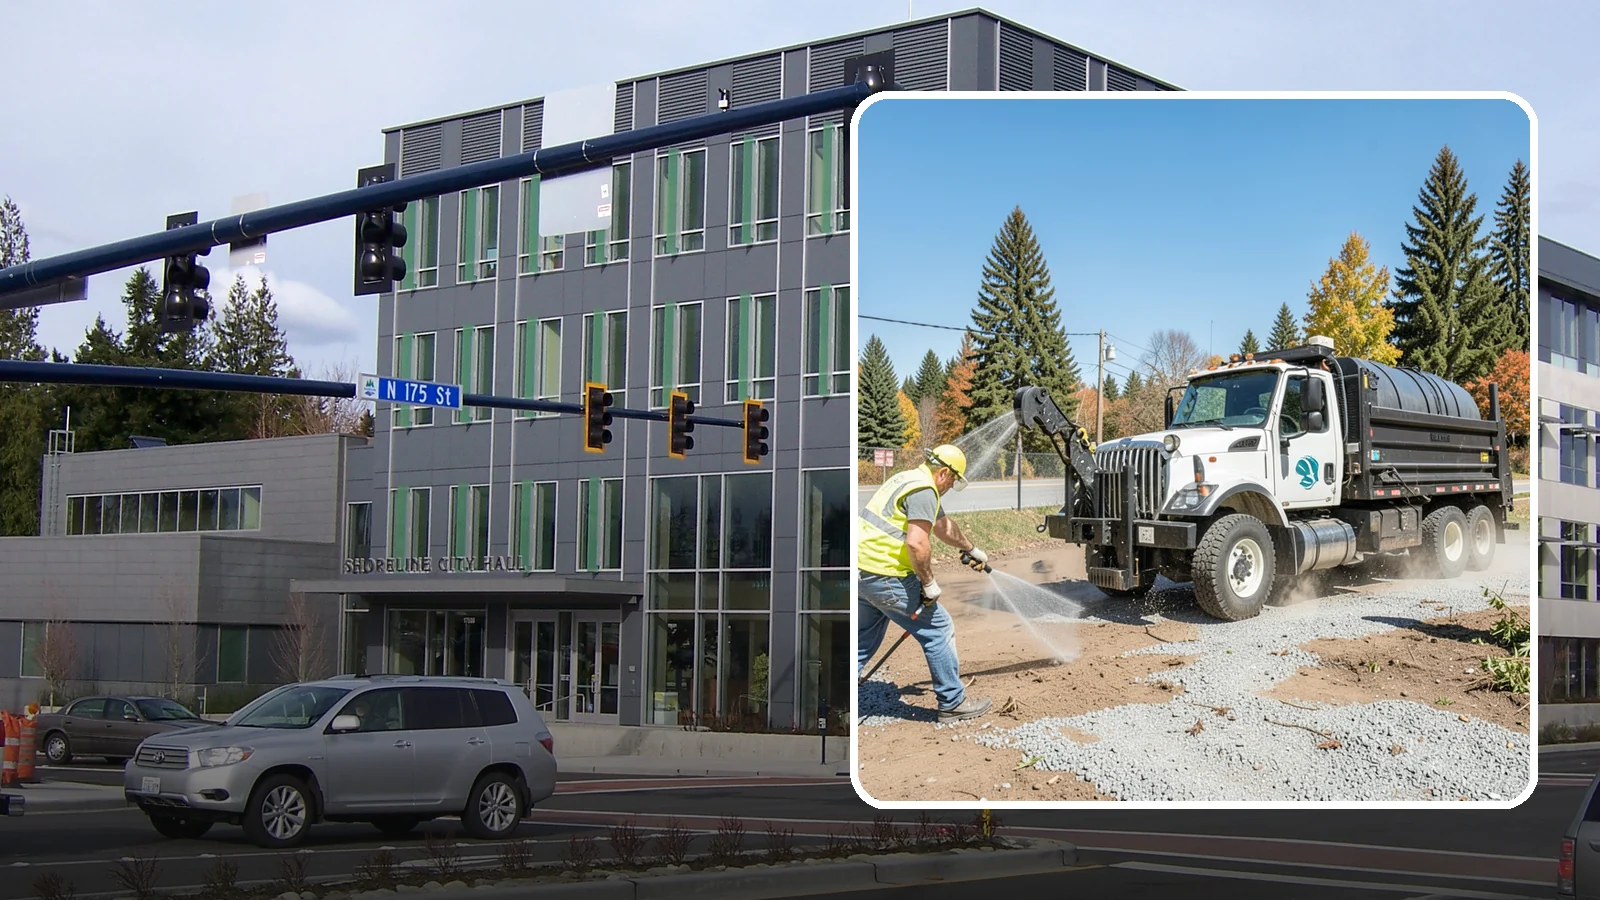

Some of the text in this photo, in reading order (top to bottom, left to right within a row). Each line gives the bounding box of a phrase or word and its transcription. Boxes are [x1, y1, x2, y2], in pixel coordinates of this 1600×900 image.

[387, 380, 451, 406] N 175 St
[344, 555, 525, 574] SHORELINE CITY HALL
